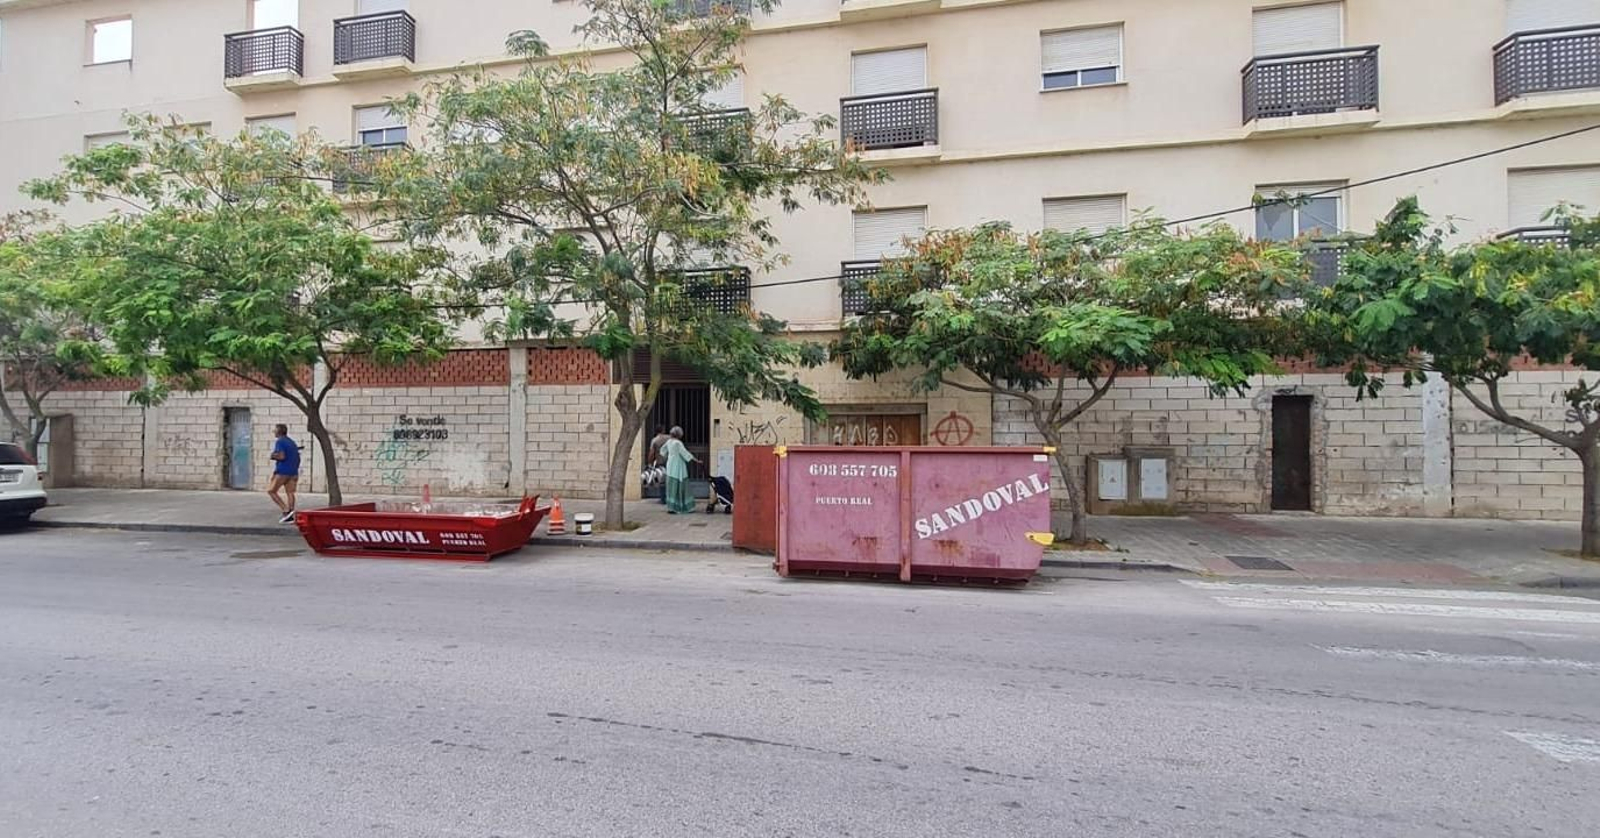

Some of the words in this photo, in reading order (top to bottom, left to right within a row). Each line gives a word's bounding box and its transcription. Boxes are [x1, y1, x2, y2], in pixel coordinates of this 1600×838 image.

[840, 464, 867, 477] 557
[870, 465, 898, 478] 705
[815, 496, 848, 505] PUERTO
[850, 496, 873, 505] REAL
[914, 473, 1050, 540] SANDOVAL
[331, 528, 430, 545] SANDOVAL
